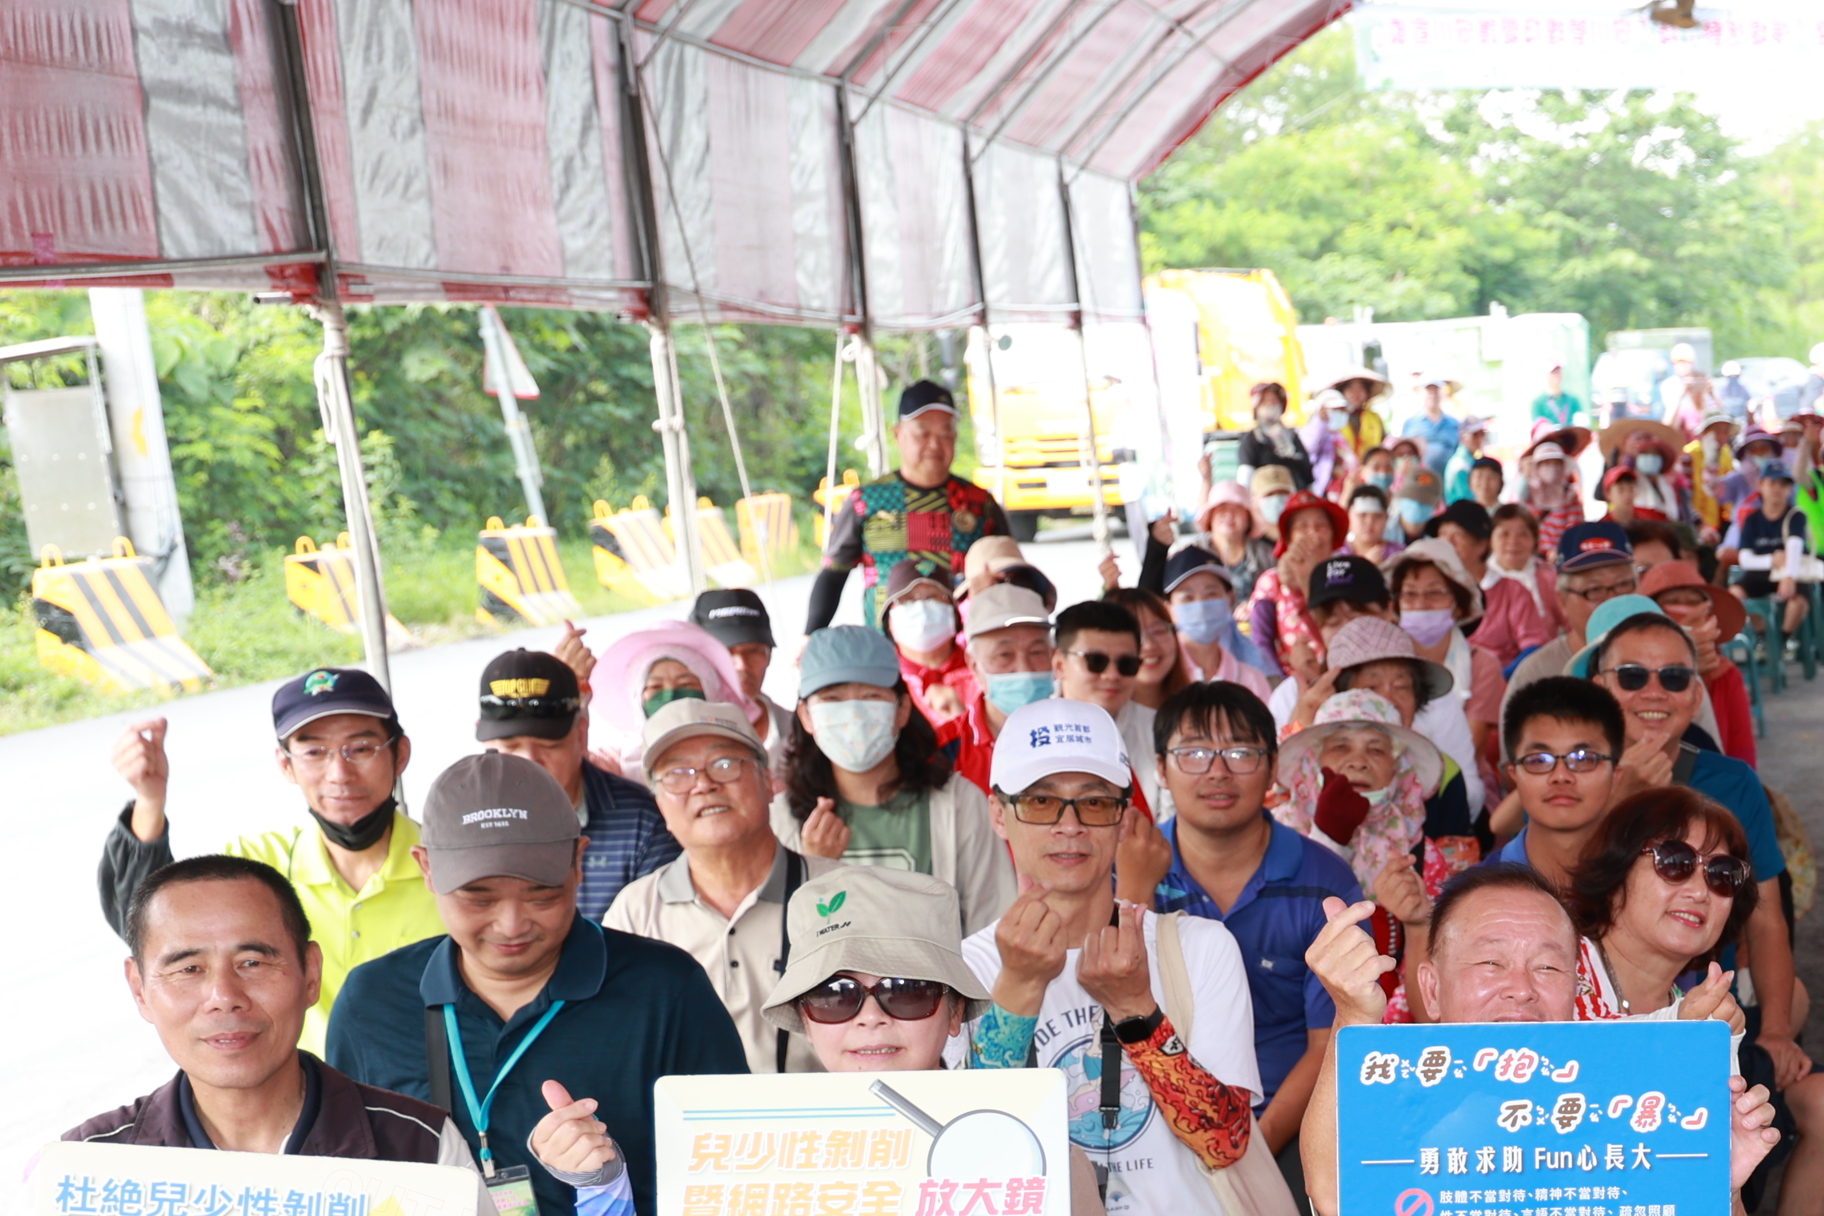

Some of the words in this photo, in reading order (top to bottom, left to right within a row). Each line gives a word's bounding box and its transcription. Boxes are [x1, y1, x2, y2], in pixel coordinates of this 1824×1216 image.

[1053, 723, 1091, 734] 觀光首都
[1054, 734, 1092, 745] 宜居城市
[462, 807, 528, 825] BROOKLYN
[819, 923, 840, 936] WATER
[687, 1128, 915, 1173] 兒少性剝削
[1126, 1158, 1154, 1171] LIFE
[1420, 1146, 1523, 1176] 勇敢求助
